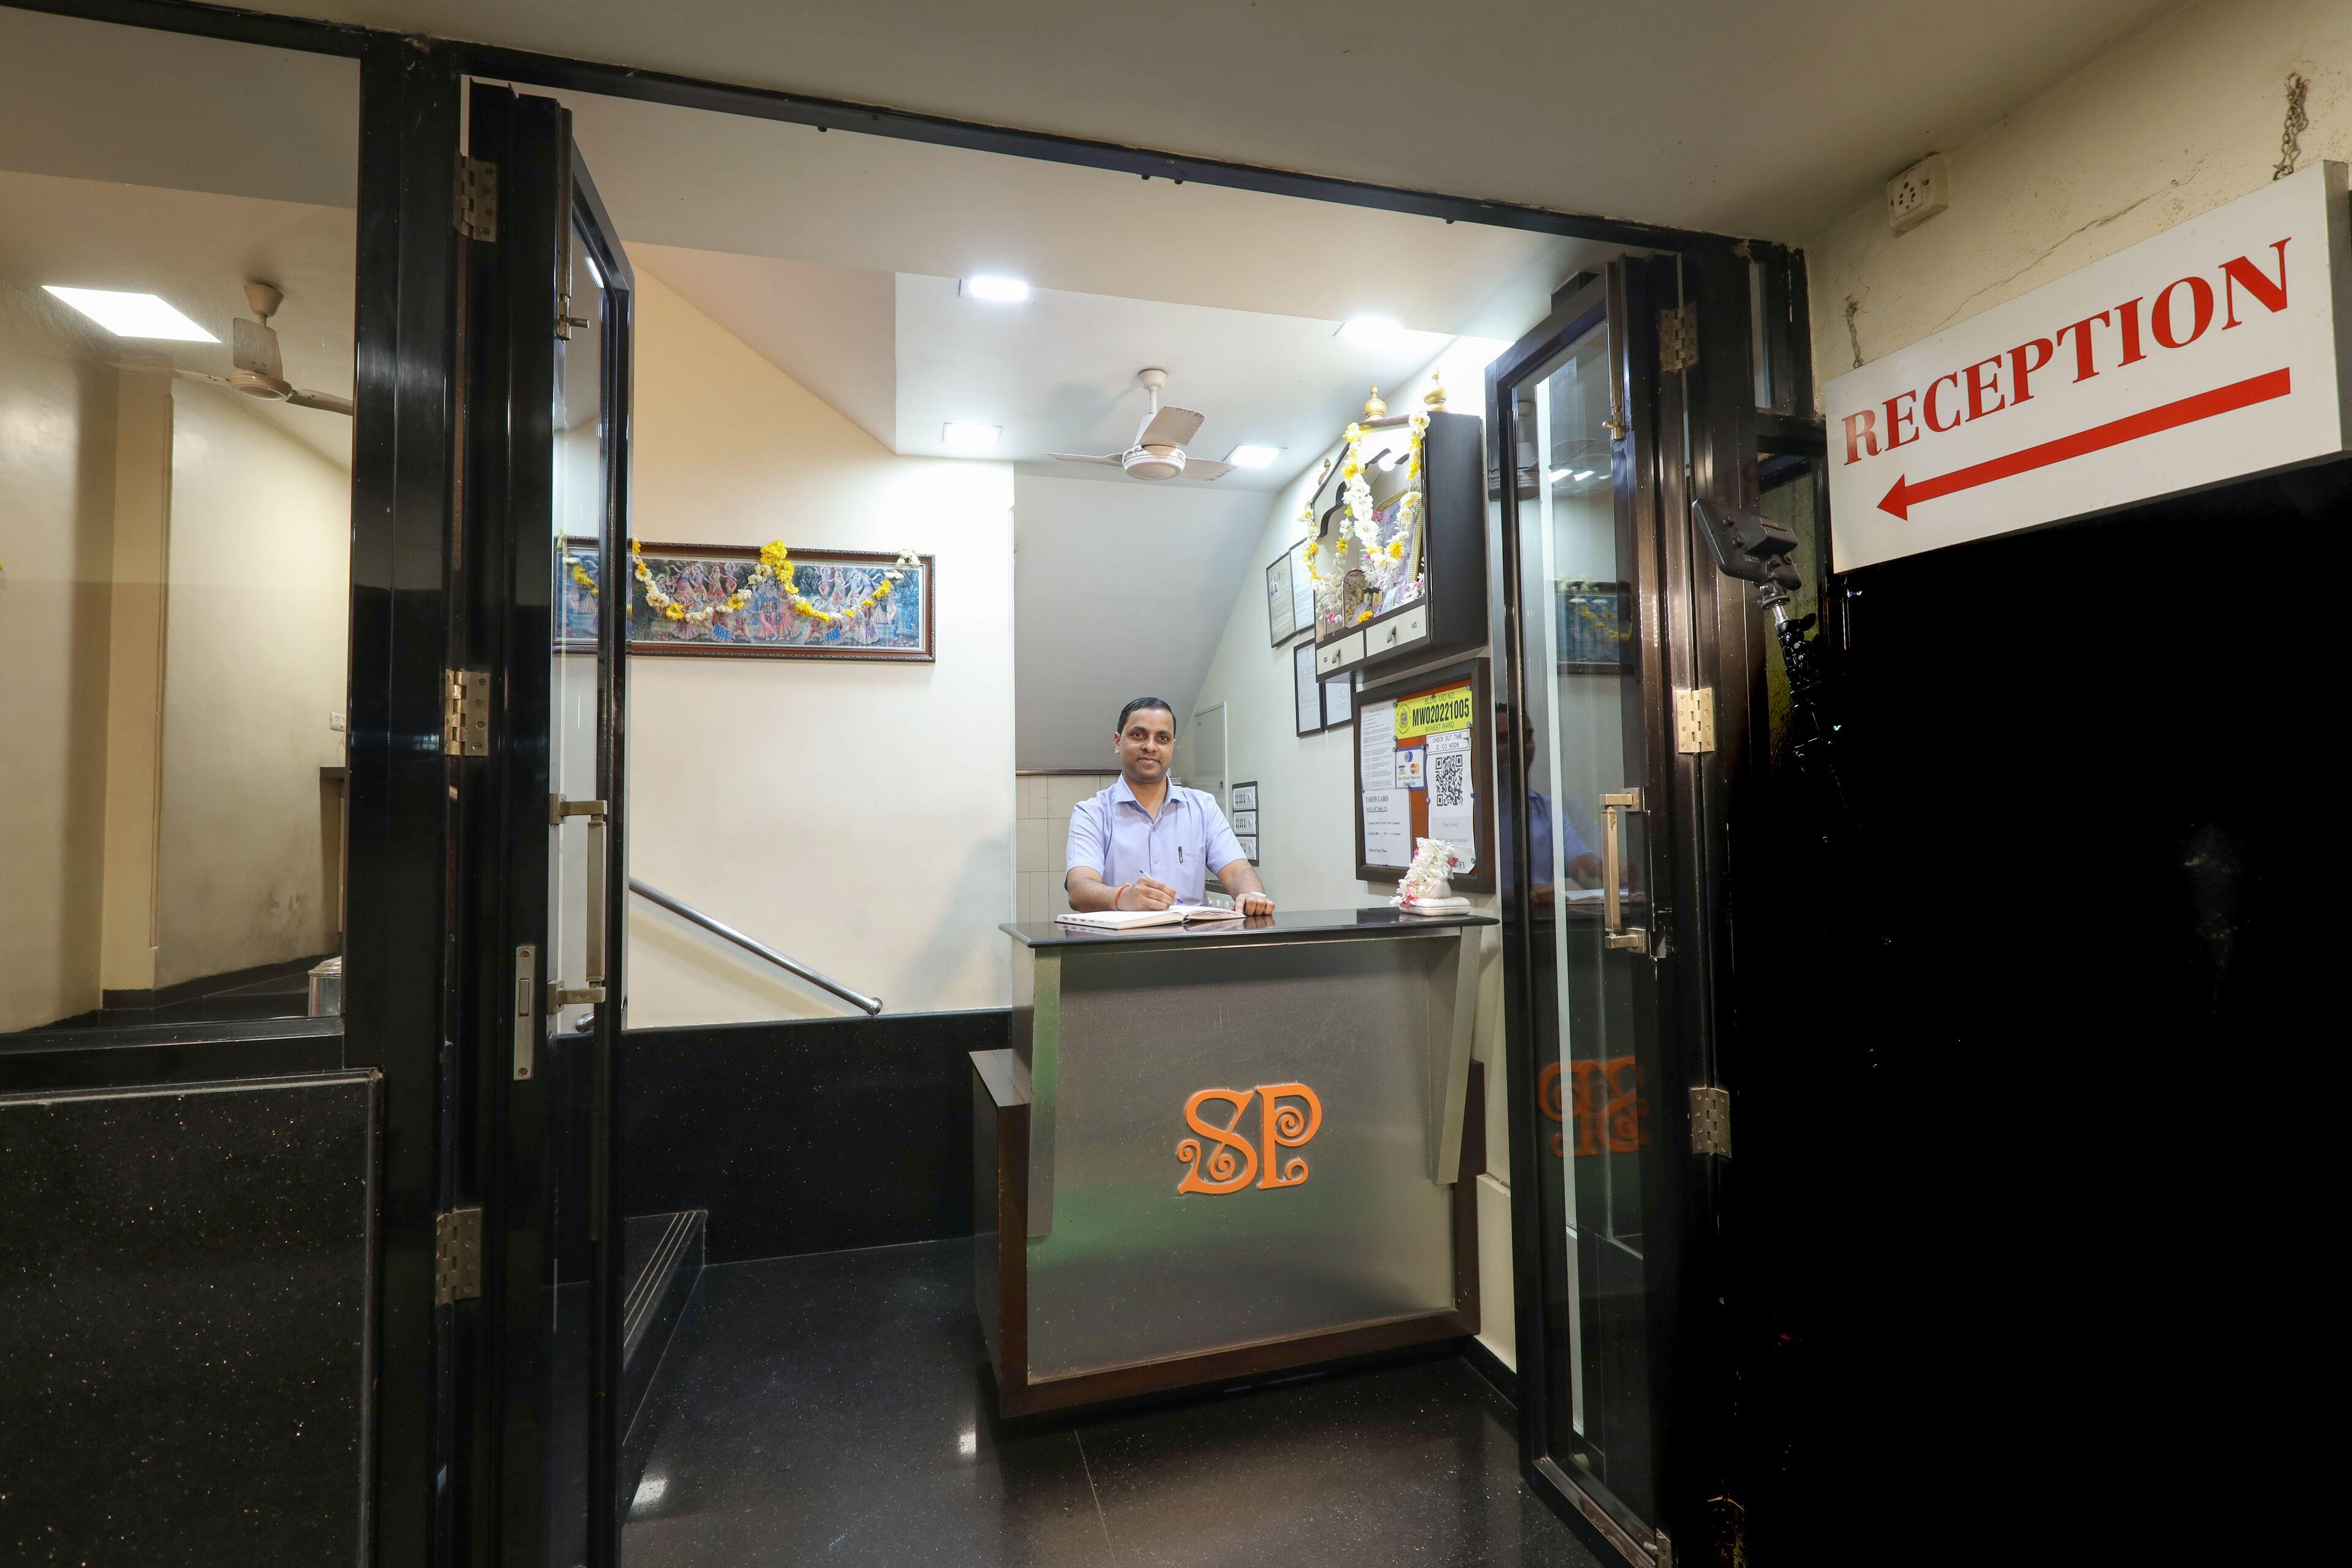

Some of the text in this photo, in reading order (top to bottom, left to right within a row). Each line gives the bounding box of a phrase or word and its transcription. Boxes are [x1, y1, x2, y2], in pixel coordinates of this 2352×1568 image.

[1841, 236, 2291, 466] RECEPTION
[1412, 698, 1469, 726] MW020221005
[1177, 1082, 1322, 1195] SP
